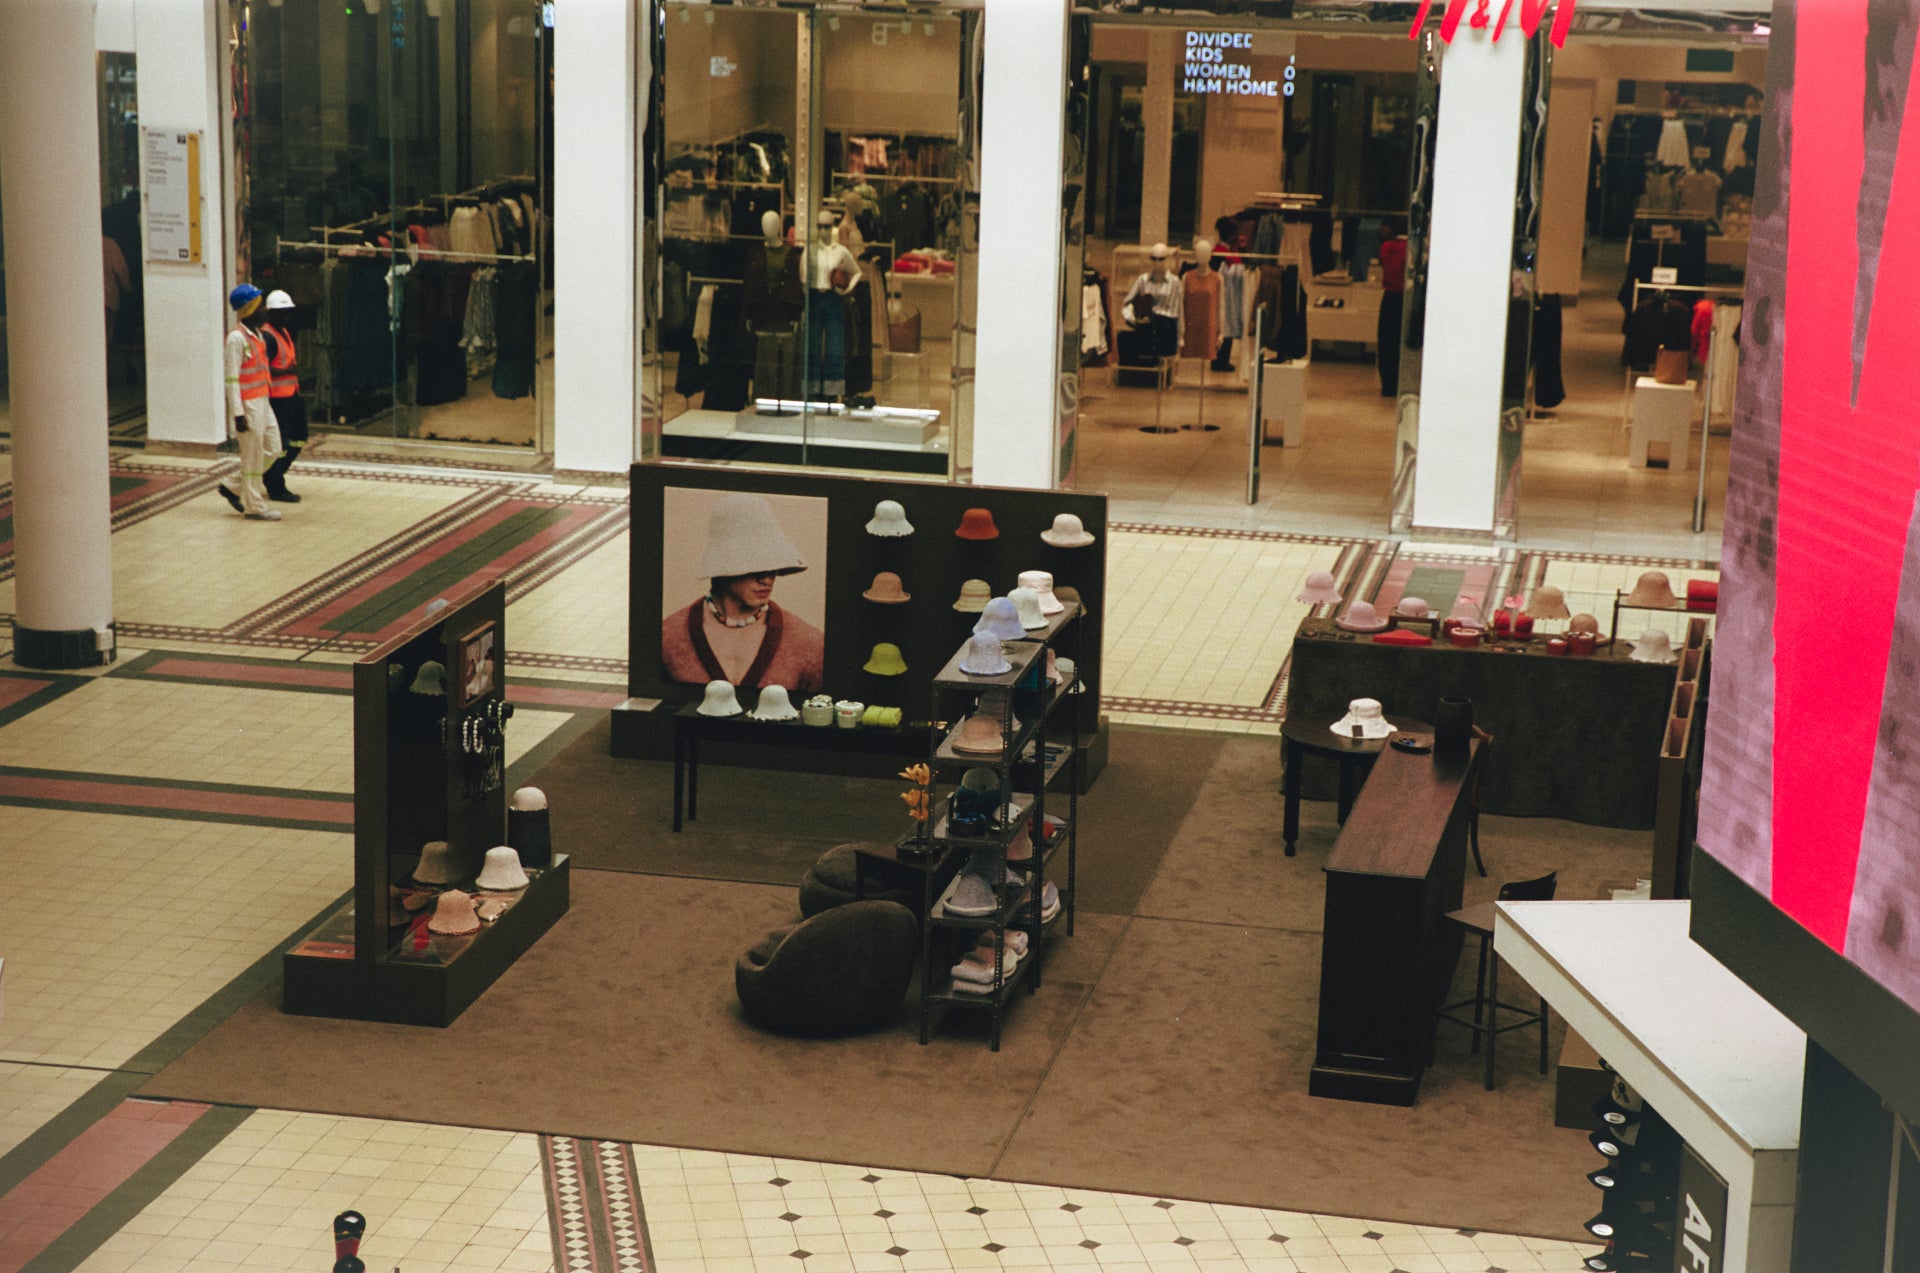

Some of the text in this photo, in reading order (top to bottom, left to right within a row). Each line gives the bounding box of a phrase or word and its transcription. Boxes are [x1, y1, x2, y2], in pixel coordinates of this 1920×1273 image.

[1185, 47, 1223, 63] KIDS
[1184, 62, 1251, 79] WOMEN
[1183, 78, 1222, 94] H&M
[1225, 79, 1278, 97] HOME
[1681, 1193, 1712, 1273] AF
